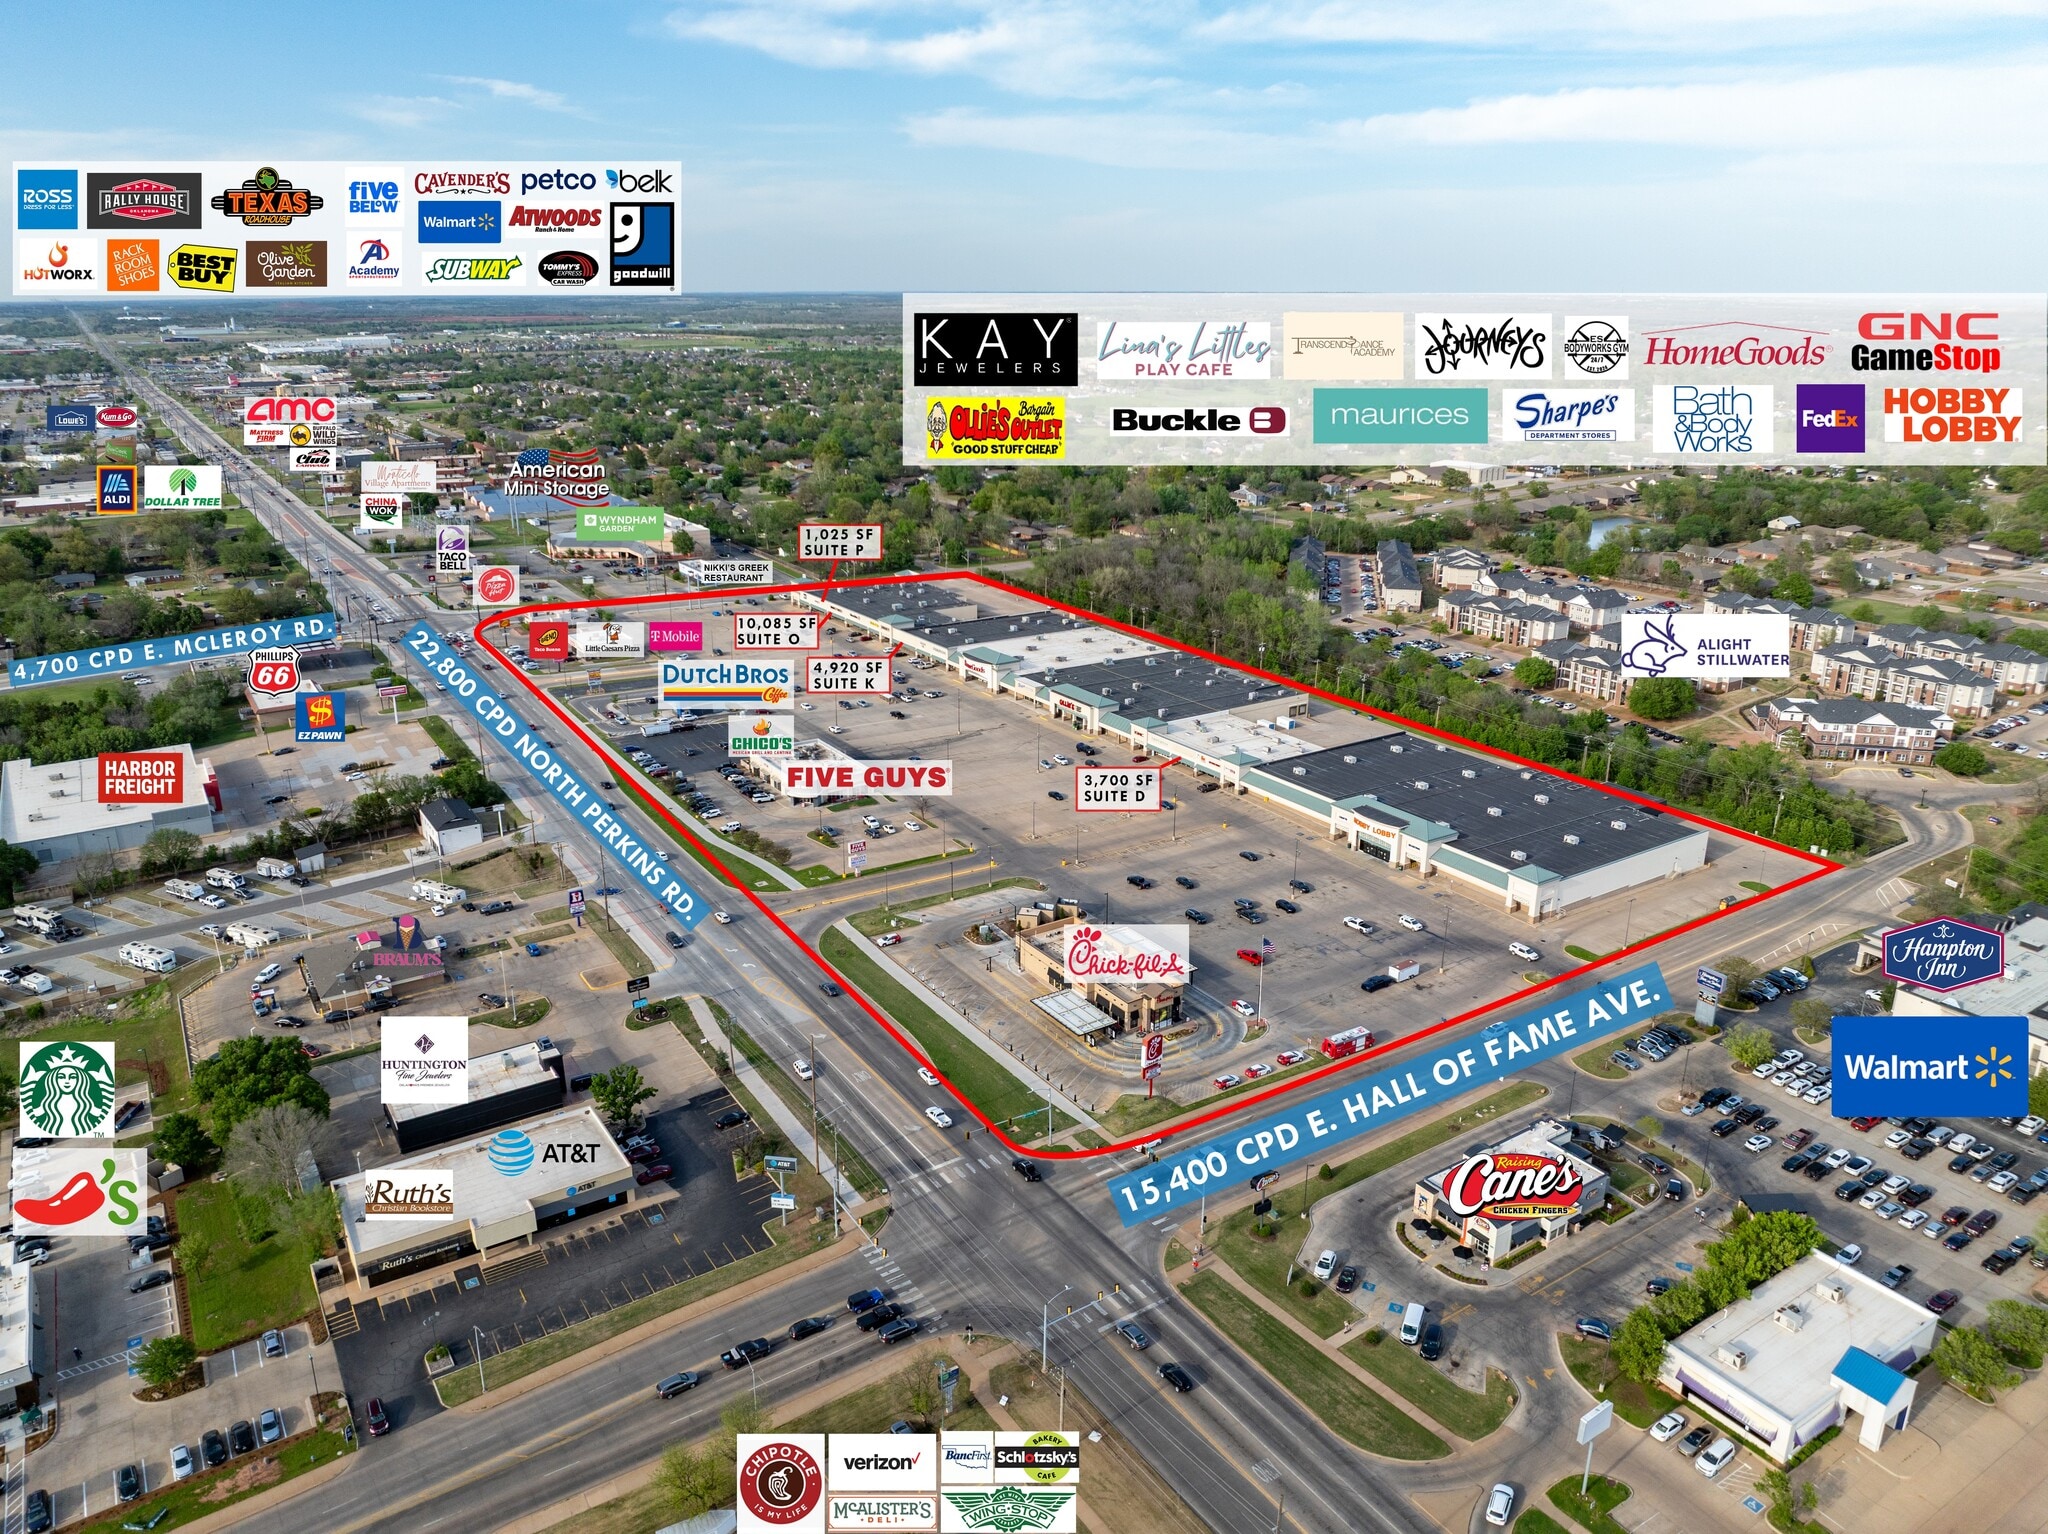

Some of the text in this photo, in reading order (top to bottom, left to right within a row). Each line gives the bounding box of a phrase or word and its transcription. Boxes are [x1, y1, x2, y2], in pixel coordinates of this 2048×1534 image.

[1373, 827, 1396, 838] LOBBY
[577, 1181, 596, 1193] AT&T
[382, 1255, 413, 1270] Ruth's
